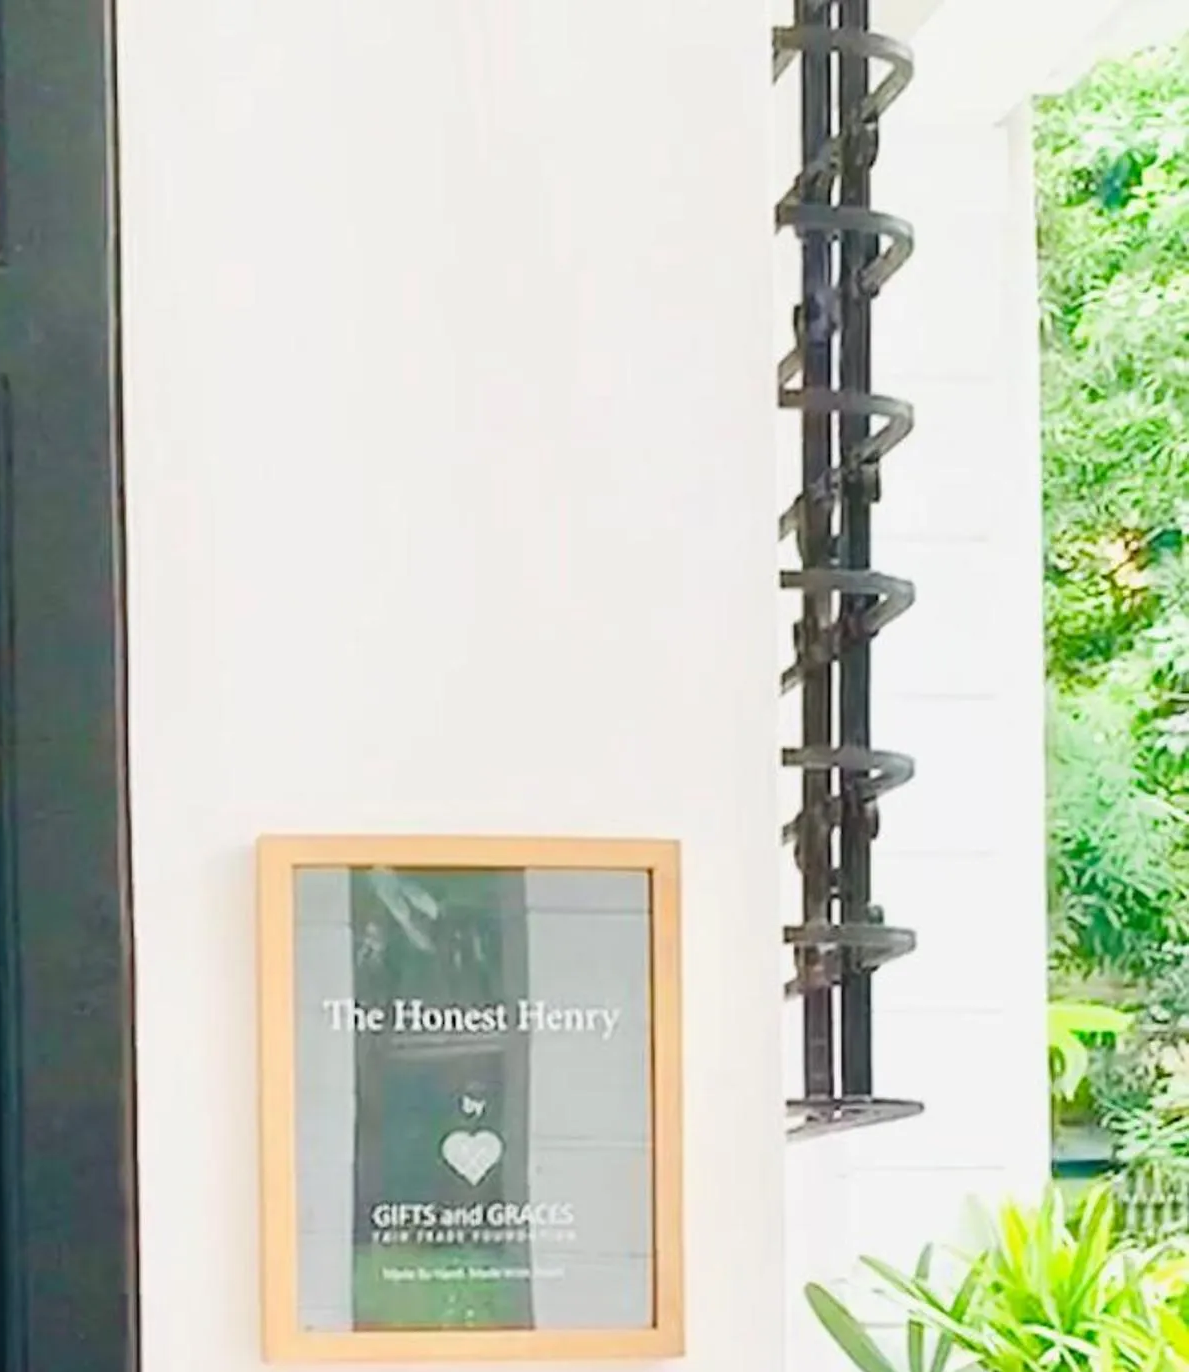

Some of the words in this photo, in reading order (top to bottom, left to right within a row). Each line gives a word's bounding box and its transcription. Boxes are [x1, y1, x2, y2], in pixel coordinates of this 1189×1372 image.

[322, 1000, 385, 1031] The
[393, 1000, 507, 1032] Honest
[517, 1000, 621, 1039] Henry
[461, 1095, 486, 1116] by
[372, 1203, 437, 1228] GIFTS
[440, 1203, 483, 1226] and
[486, 1203, 574, 1226] GRACES
